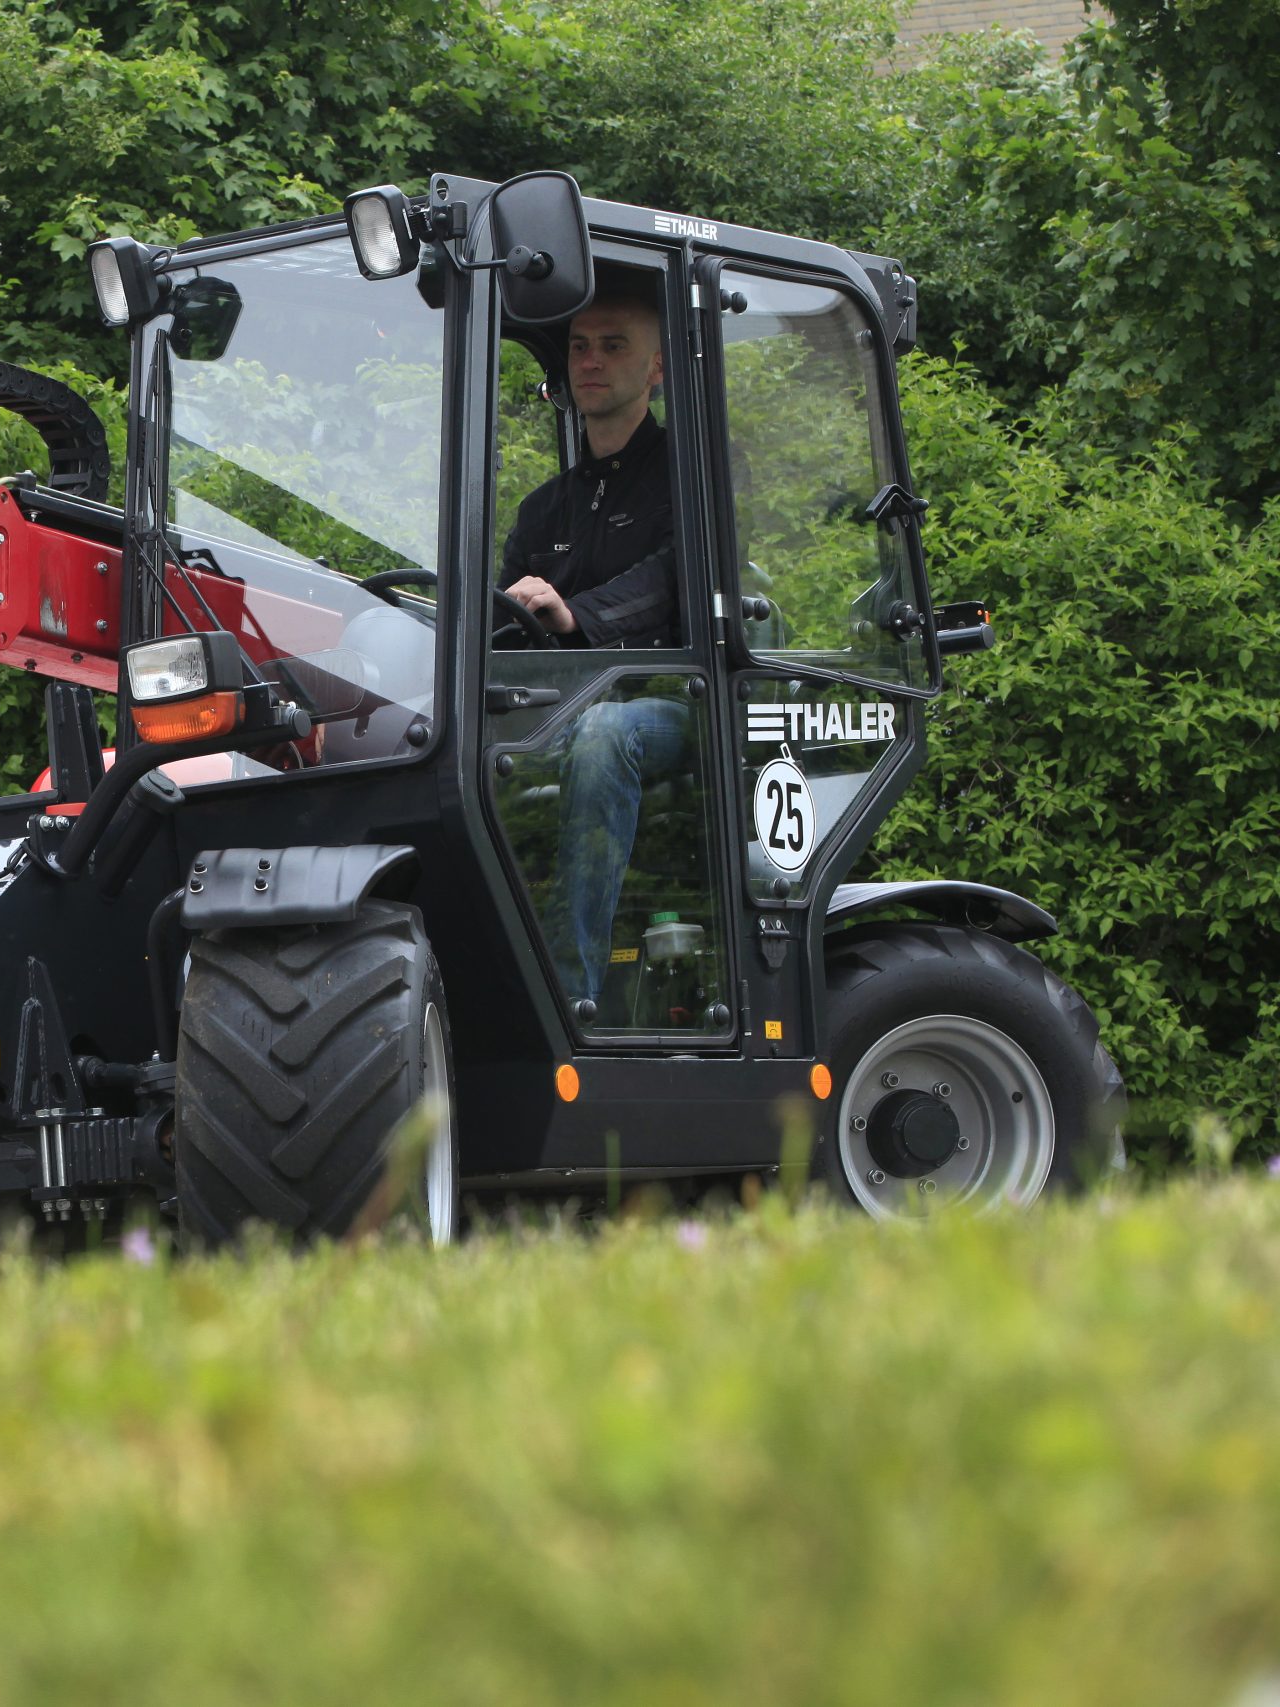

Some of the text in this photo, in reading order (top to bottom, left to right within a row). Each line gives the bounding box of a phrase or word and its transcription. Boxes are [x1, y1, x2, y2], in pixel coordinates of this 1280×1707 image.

[670, 218, 718, 240] THALER
[785, 702, 896, 741] THALER
[767, 779, 804, 852] 25
